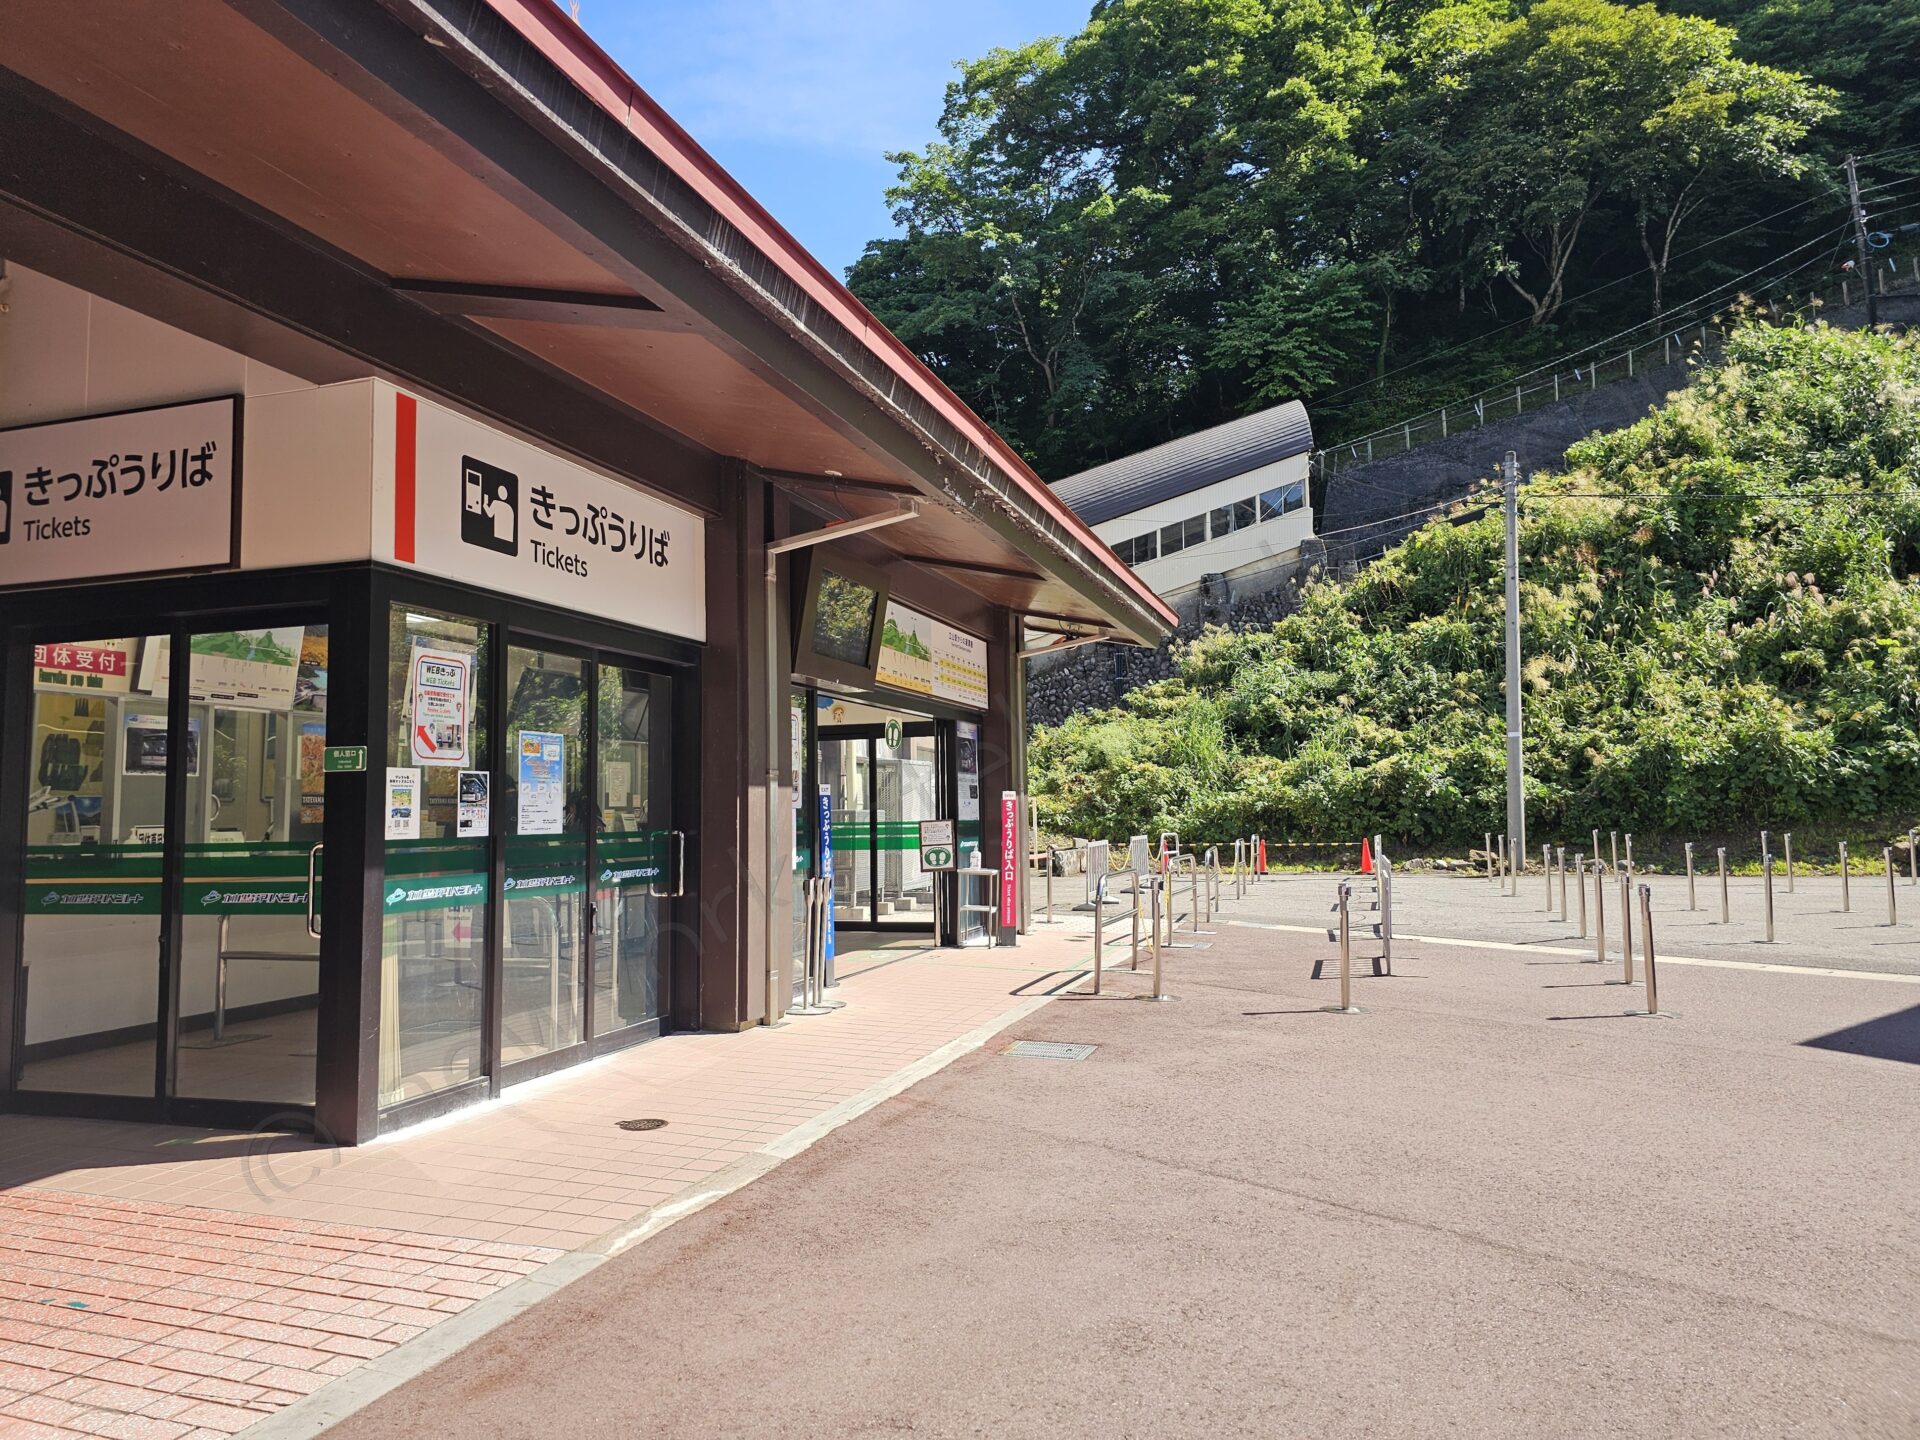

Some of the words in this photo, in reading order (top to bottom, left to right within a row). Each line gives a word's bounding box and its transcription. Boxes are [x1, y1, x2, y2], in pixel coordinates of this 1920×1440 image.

[24, 440, 217, 507] きっぷうりば
[23, 515, 91, 542] Tickets
[530, 484, 671, 567] きっぷうりば
[530, 539, 588, 578] Tickets
[34, 645, 117, 672] 団体受付
